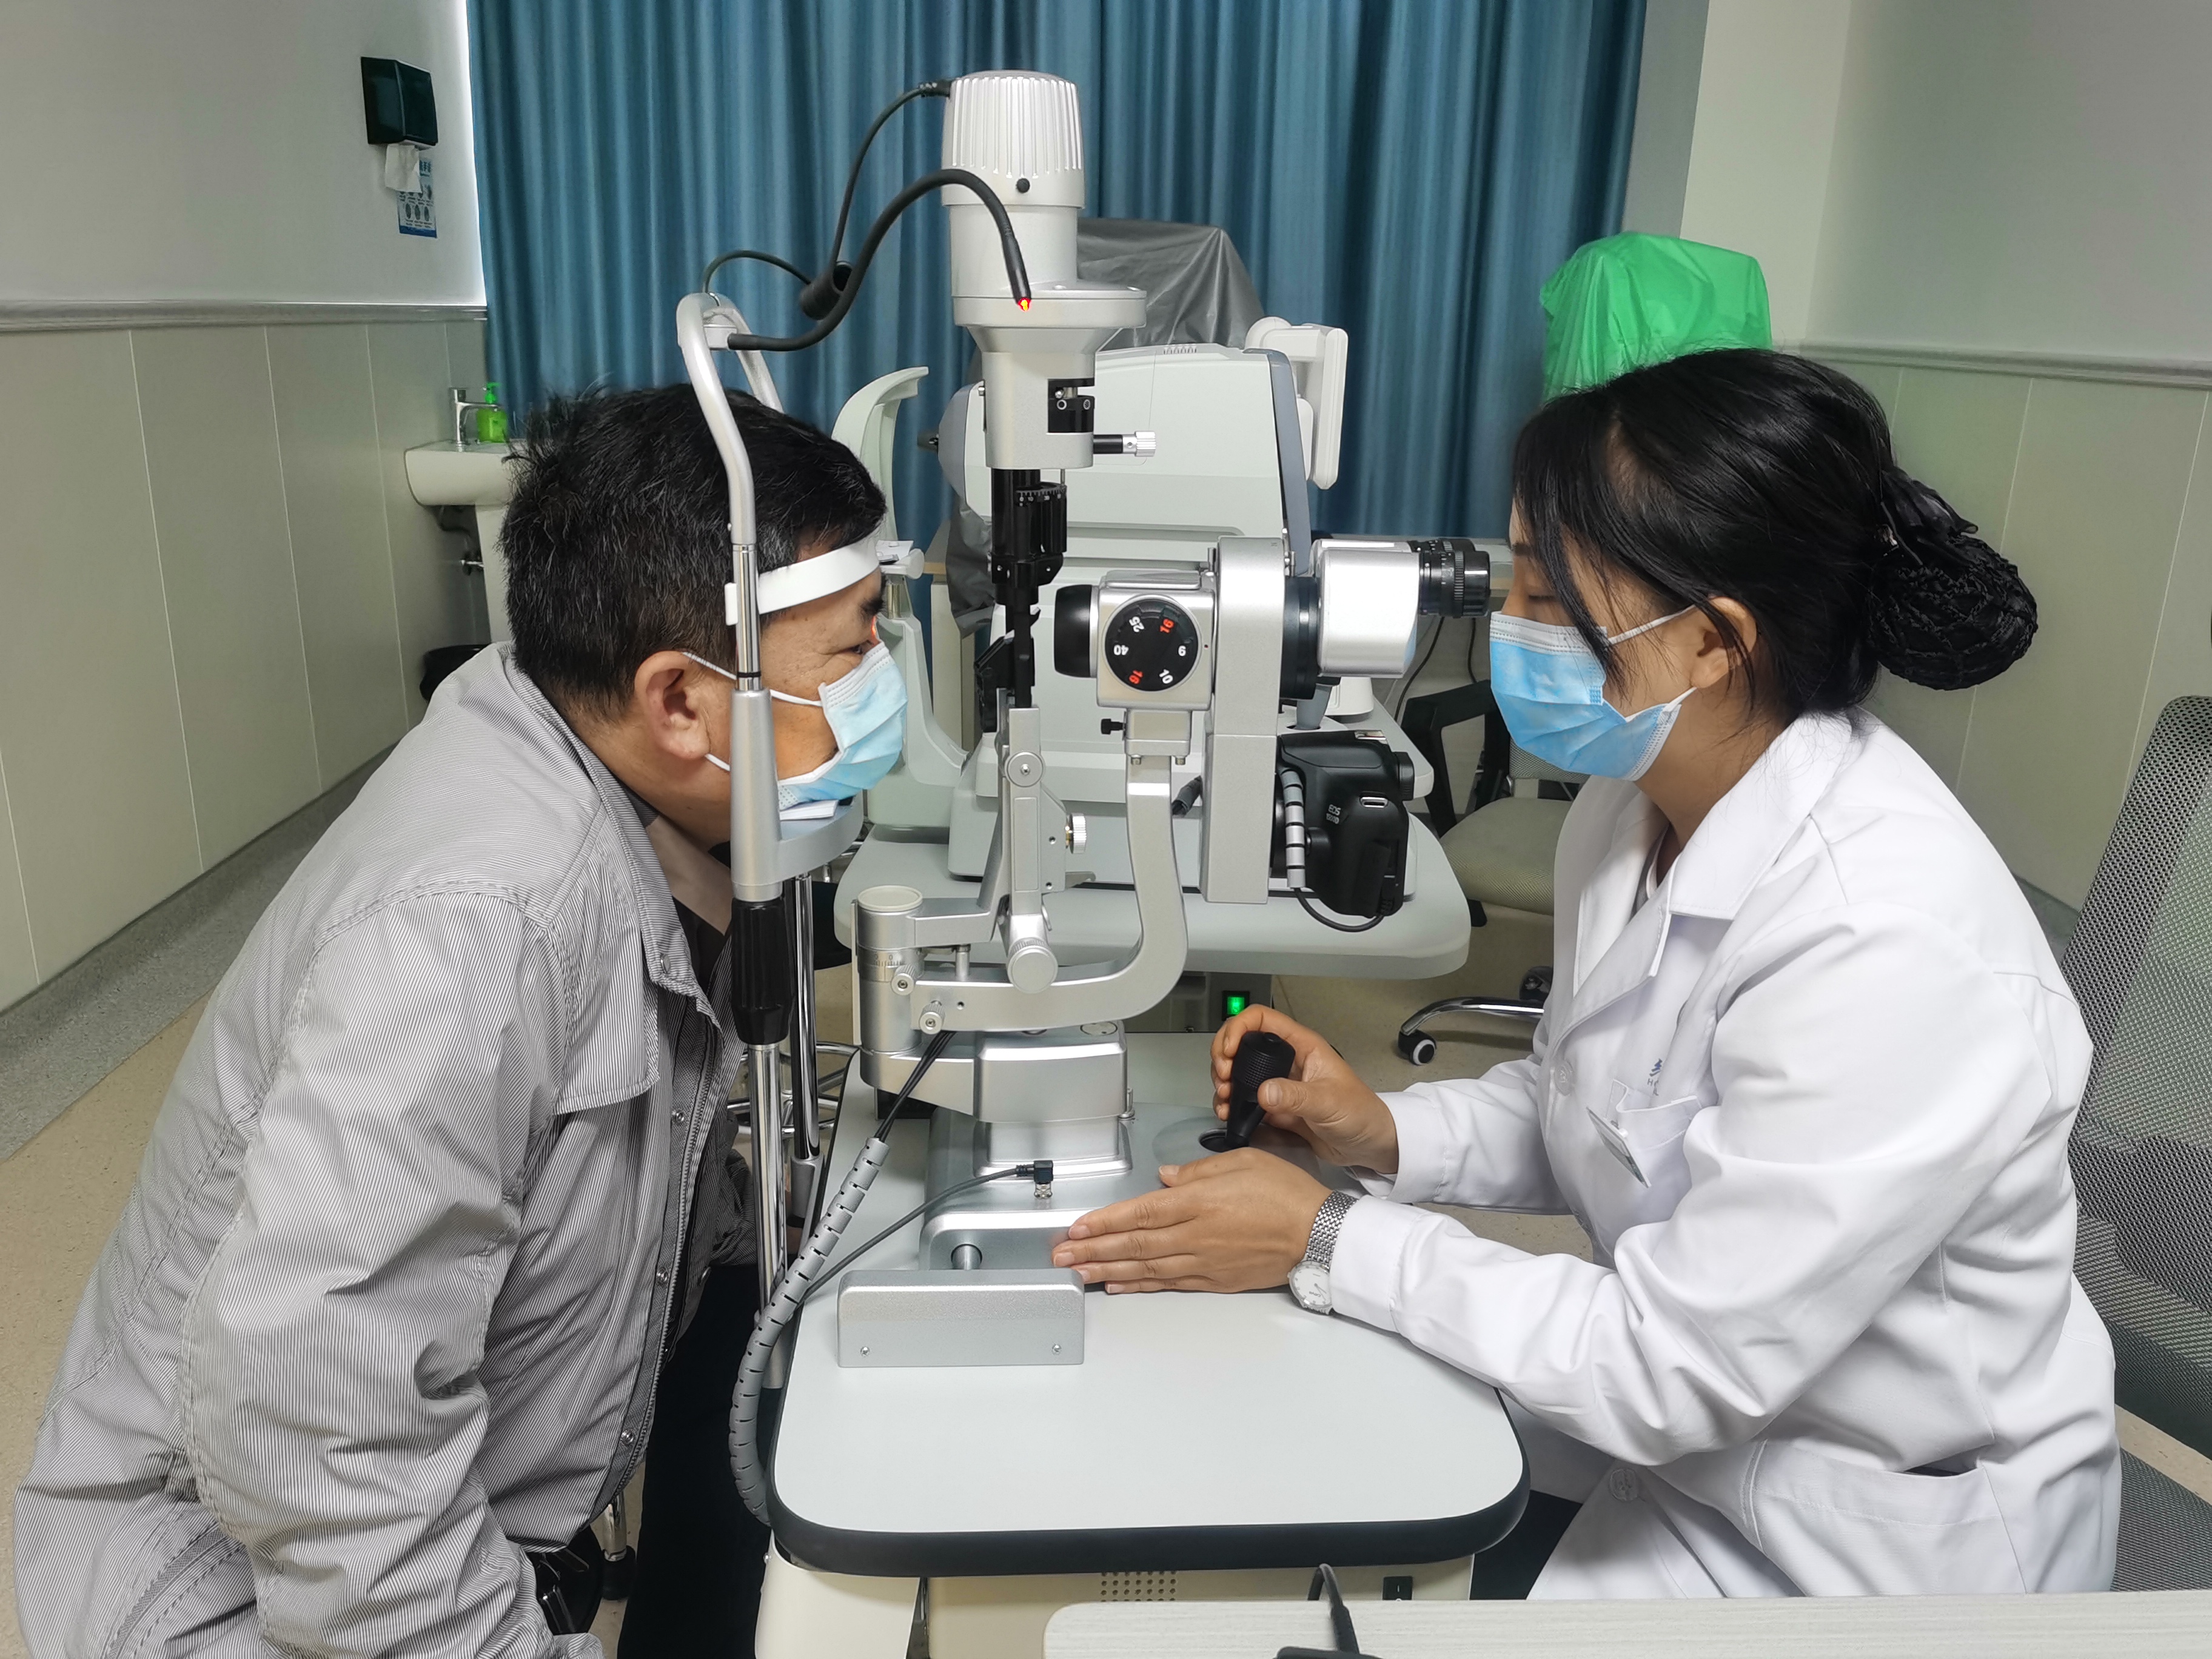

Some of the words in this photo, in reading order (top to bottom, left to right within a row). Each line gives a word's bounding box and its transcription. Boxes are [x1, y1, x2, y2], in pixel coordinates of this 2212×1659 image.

[1128, 616, 1145, 632] 25
[1159, 618, 1175, 634] 16
[1113, 645, 1129, 655] 40
[1178, 645, 1186, 657] 6
[1128, 669, 1144, 685] 16
[1159, 669, 1173, 684] 10
[1328, 804, 1341, 816] EOS
